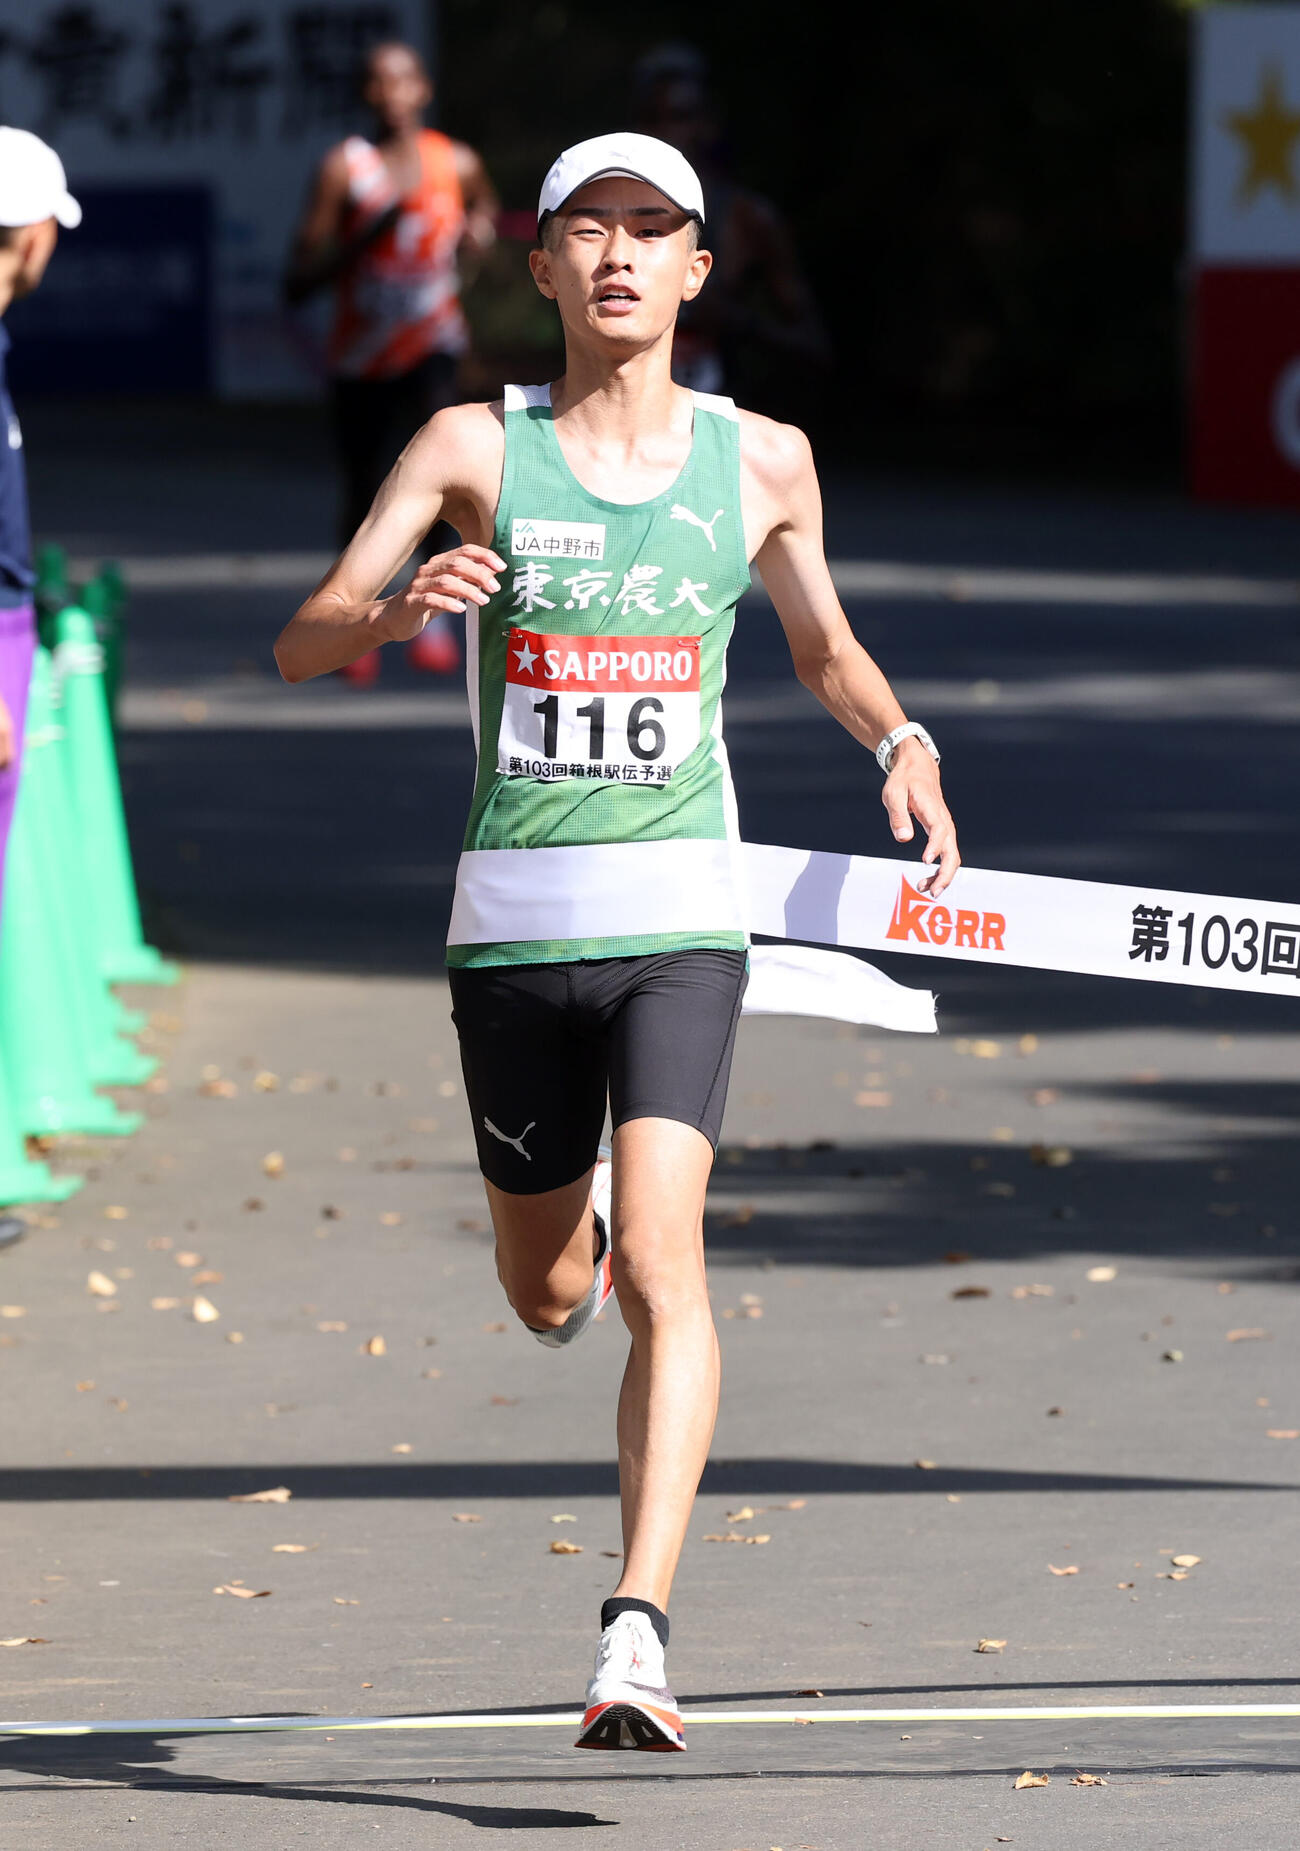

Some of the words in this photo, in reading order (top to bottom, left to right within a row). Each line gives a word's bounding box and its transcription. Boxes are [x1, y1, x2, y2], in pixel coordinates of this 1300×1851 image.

[515, 536, 601, 557] JA中野市
[512, 561, 715, 617] 東京農大
[544, 649, 693, 681] SAPPORO
[533, 694, 667, 761] 116
[1128, 904, 1300, 979] 第103回
